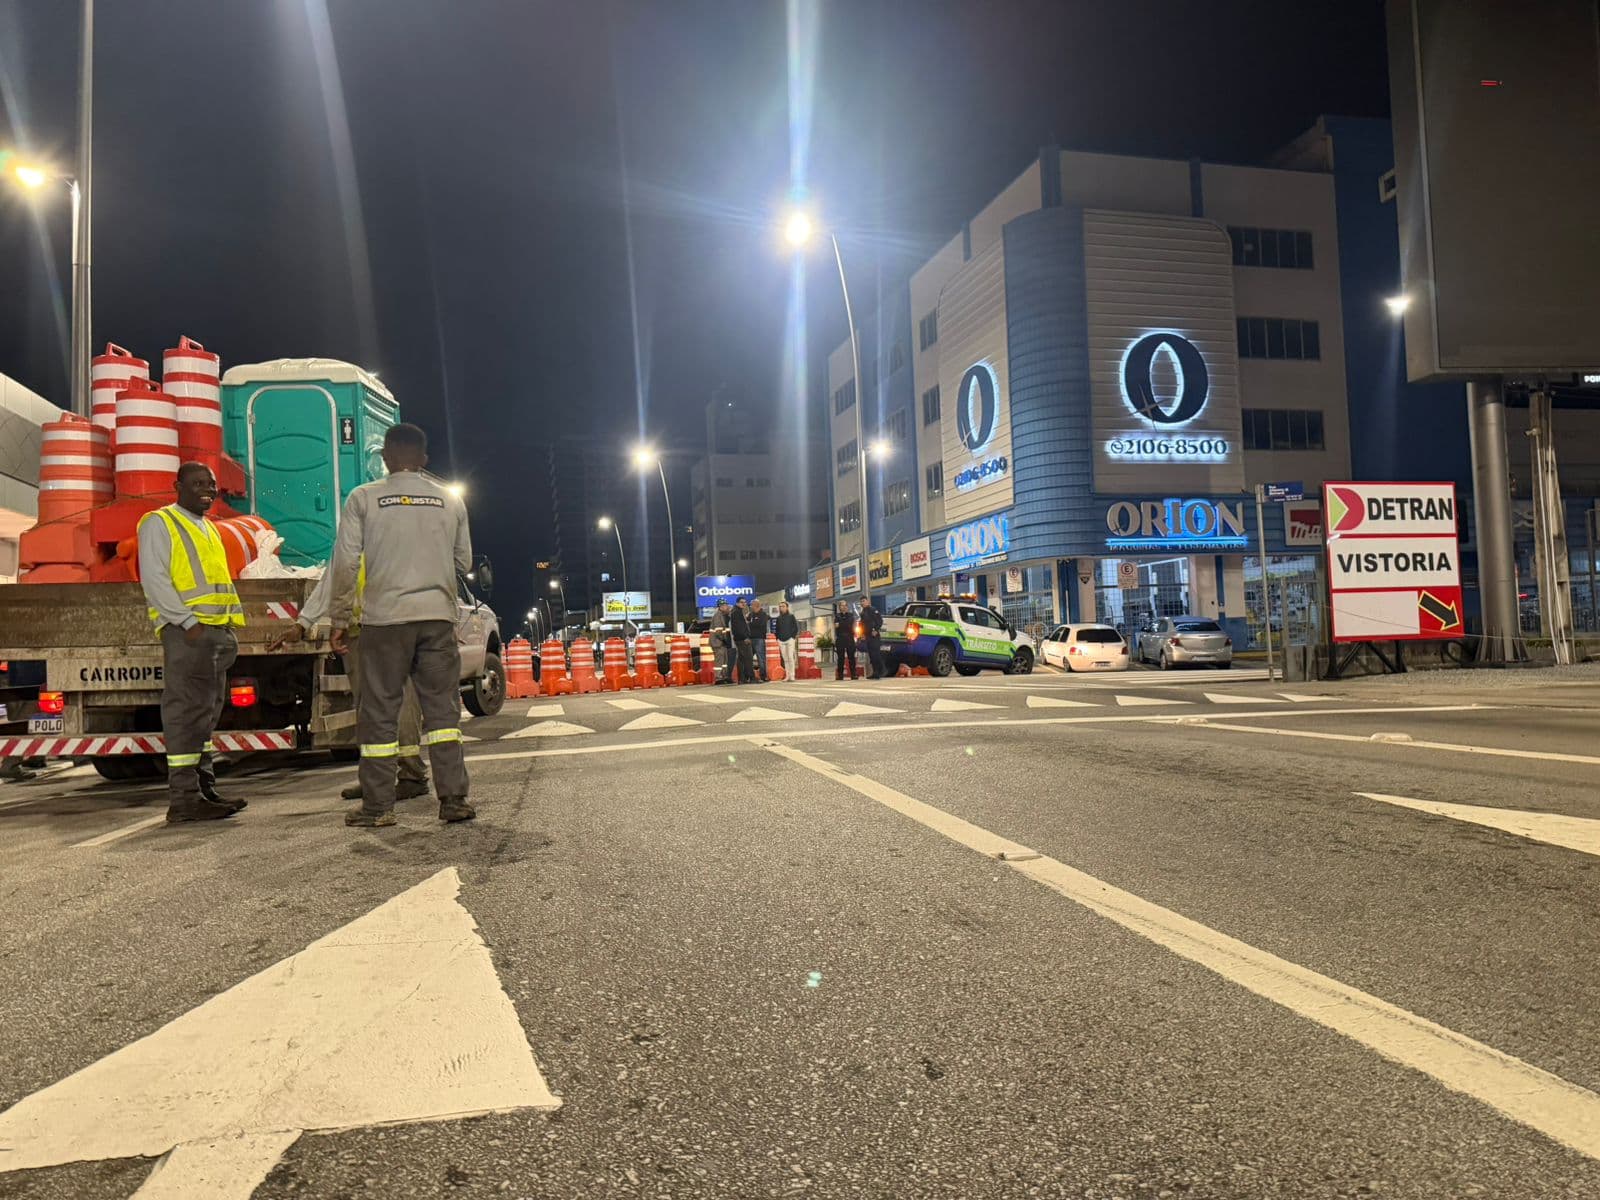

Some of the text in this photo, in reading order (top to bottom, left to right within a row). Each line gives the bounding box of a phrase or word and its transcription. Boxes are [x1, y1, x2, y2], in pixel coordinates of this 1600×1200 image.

[379, 495, 443, 506] CONQUISTAR
[1367, 497, 1453, 521] DETRAN
[1106, 500, 1246, 537] ORION
[945, 513, 1009, 561] ORION
[1337, 552, 1452, 573] VISTORIA
[699, 586, 753, 597] Ortobom
[80, 666, 163, 682] CARROPE
